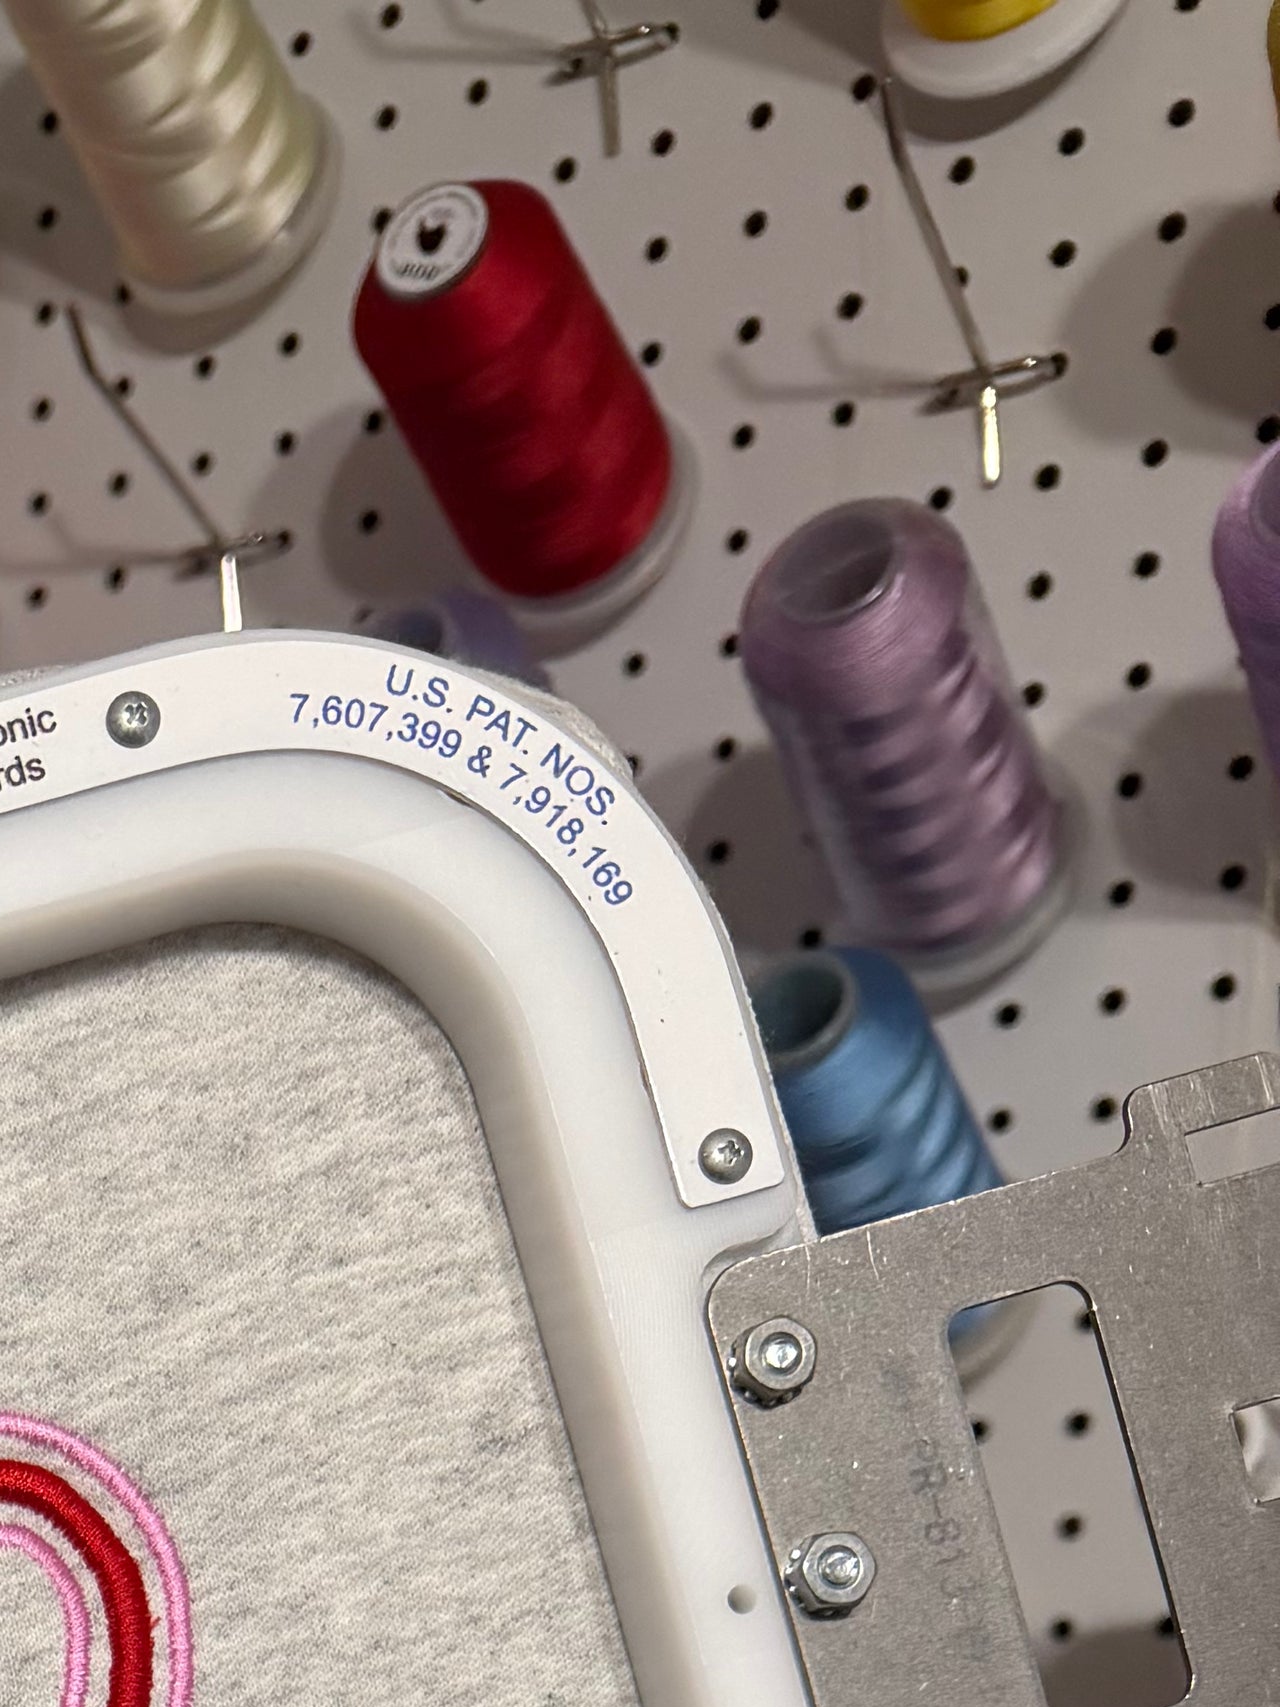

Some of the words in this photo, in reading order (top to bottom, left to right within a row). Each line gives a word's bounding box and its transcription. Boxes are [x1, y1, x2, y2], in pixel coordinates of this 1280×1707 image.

[289, 693, 463, 759] 7,607,399
[467, 745, 493, 779] &
[499, 762, 633, 906] 7,918,169
[386, 663, 453, 714] U.S.
[465, 694, 539, 756] PAT.
[539, 742, 616, 826] NOS.
